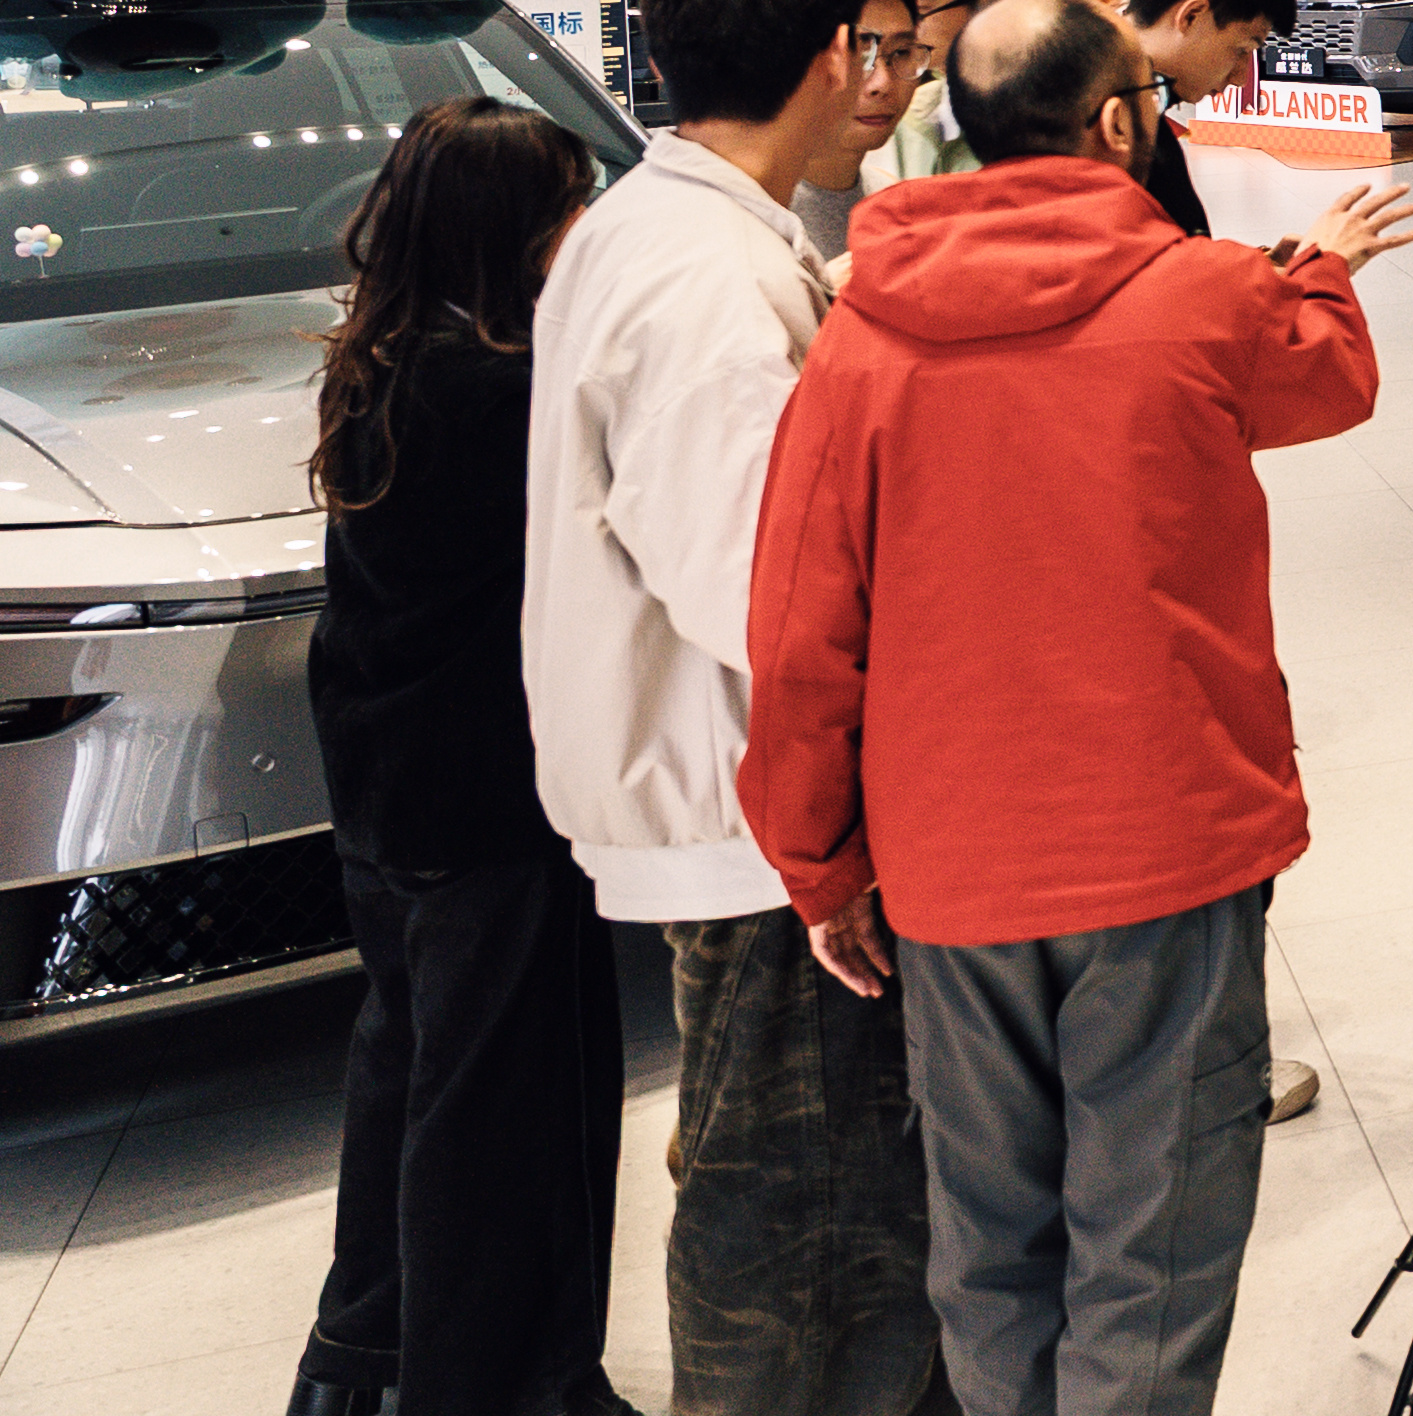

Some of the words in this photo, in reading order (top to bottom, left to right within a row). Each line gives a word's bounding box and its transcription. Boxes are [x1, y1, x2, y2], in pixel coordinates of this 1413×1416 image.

[1275, 61, 1313, 75] 威兰达
[1211, 87, 1369, 124] WDLANDER
